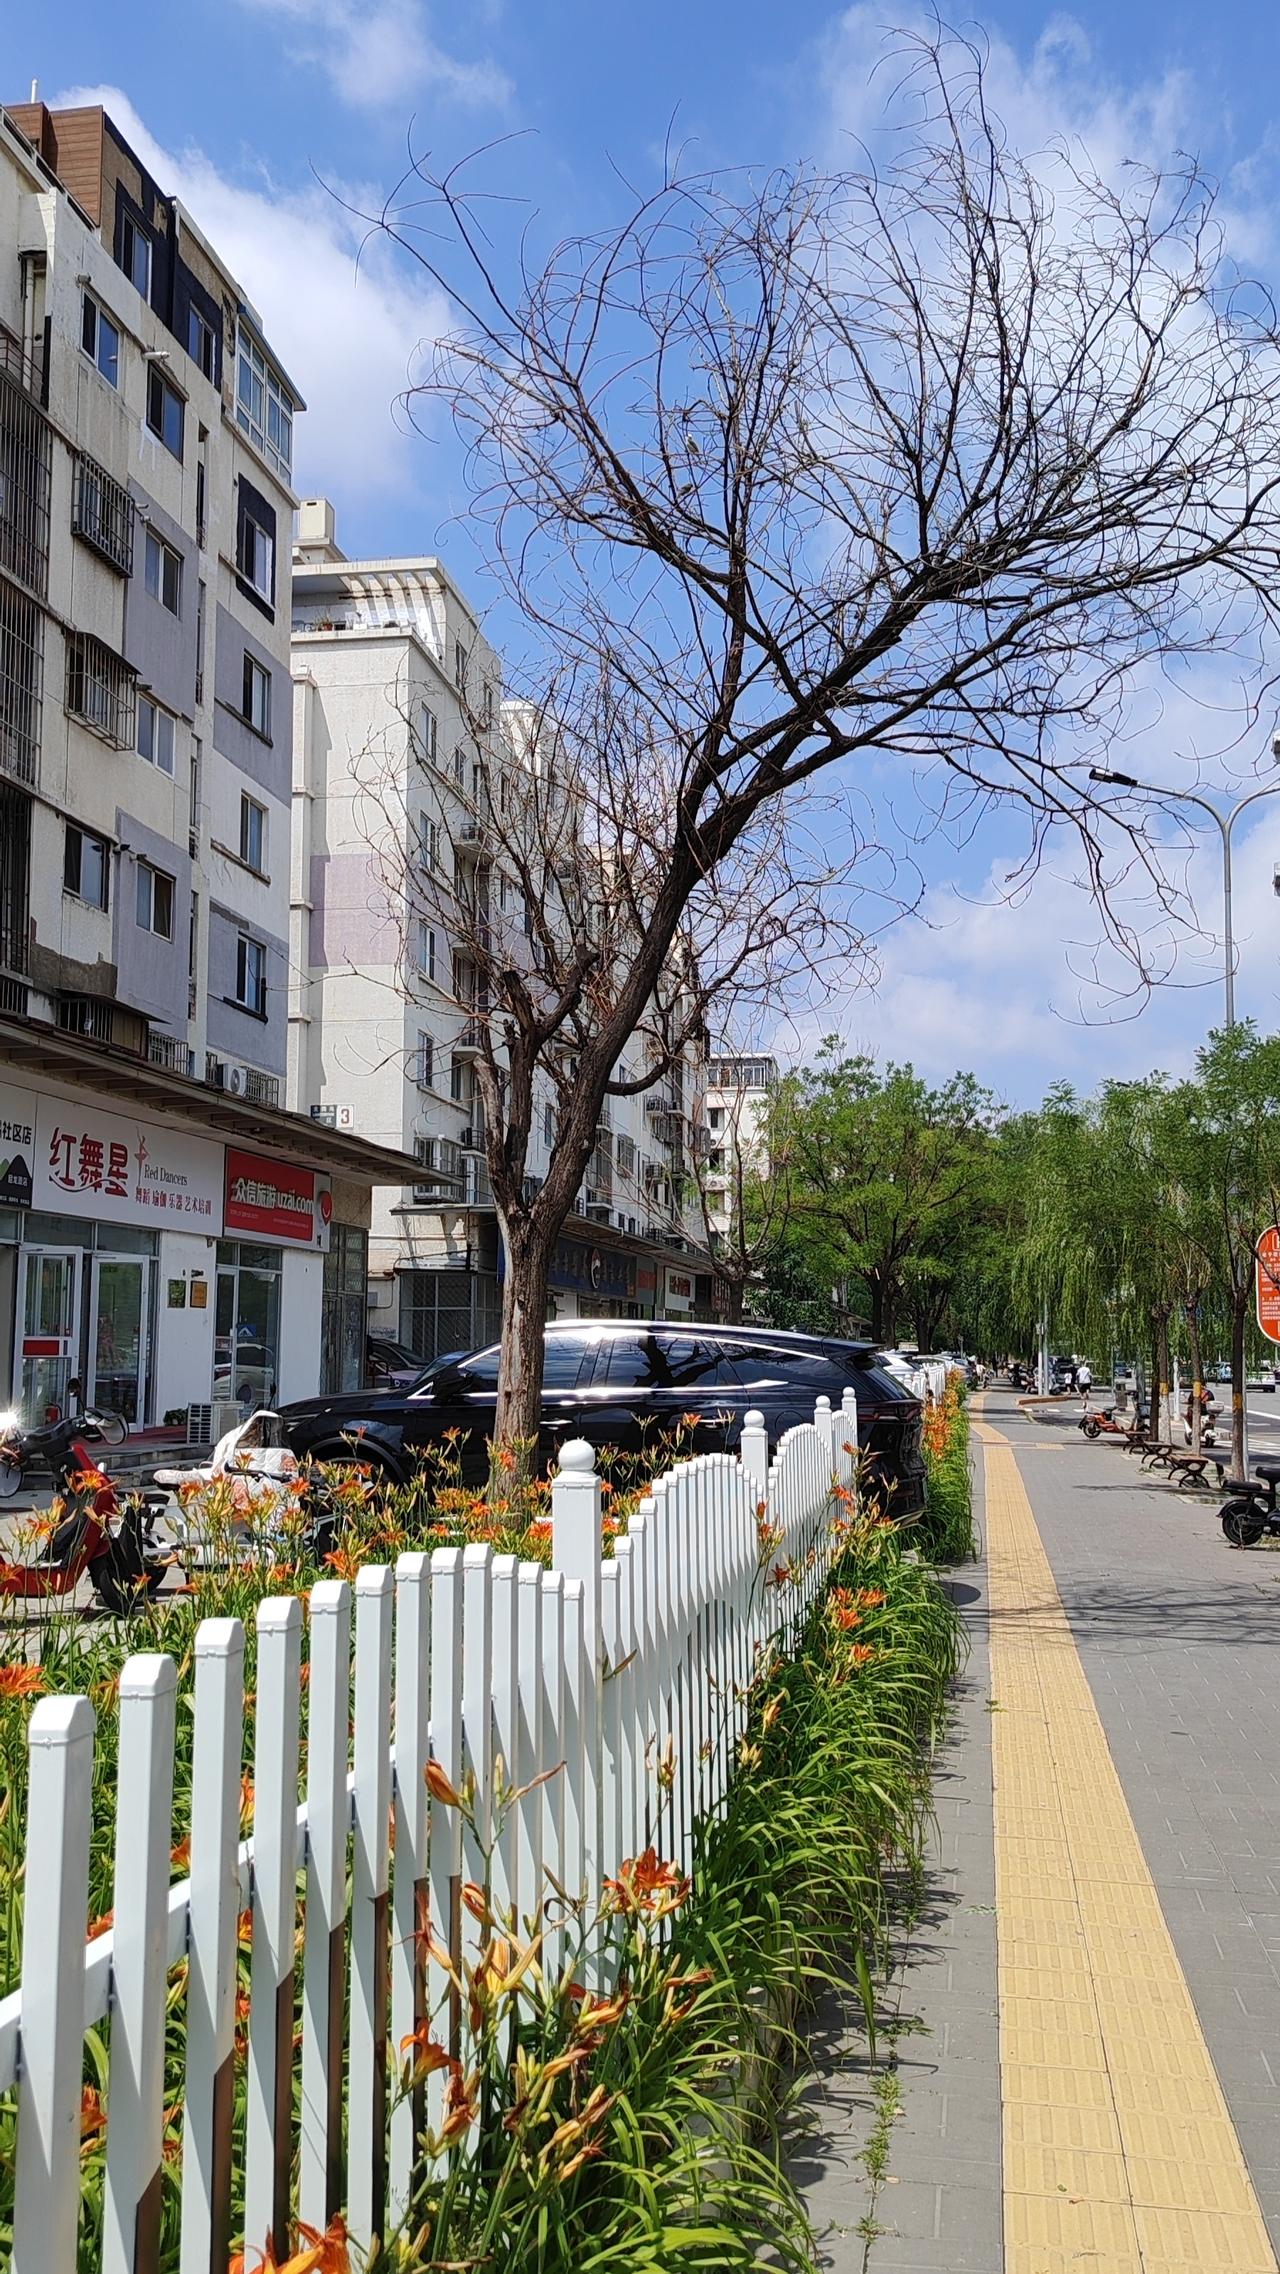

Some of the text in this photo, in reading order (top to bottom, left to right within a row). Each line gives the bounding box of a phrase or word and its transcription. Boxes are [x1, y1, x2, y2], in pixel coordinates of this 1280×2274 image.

[341, 1109, 350, 1124] 3
[144, 1164, 188, 1186] Red Dancers
[135, 1186, 150, 1205] 舞蹈
[168, 1192, 183, 1211] 乐器
[185, 1195, 212, 1215] 艺术培训
